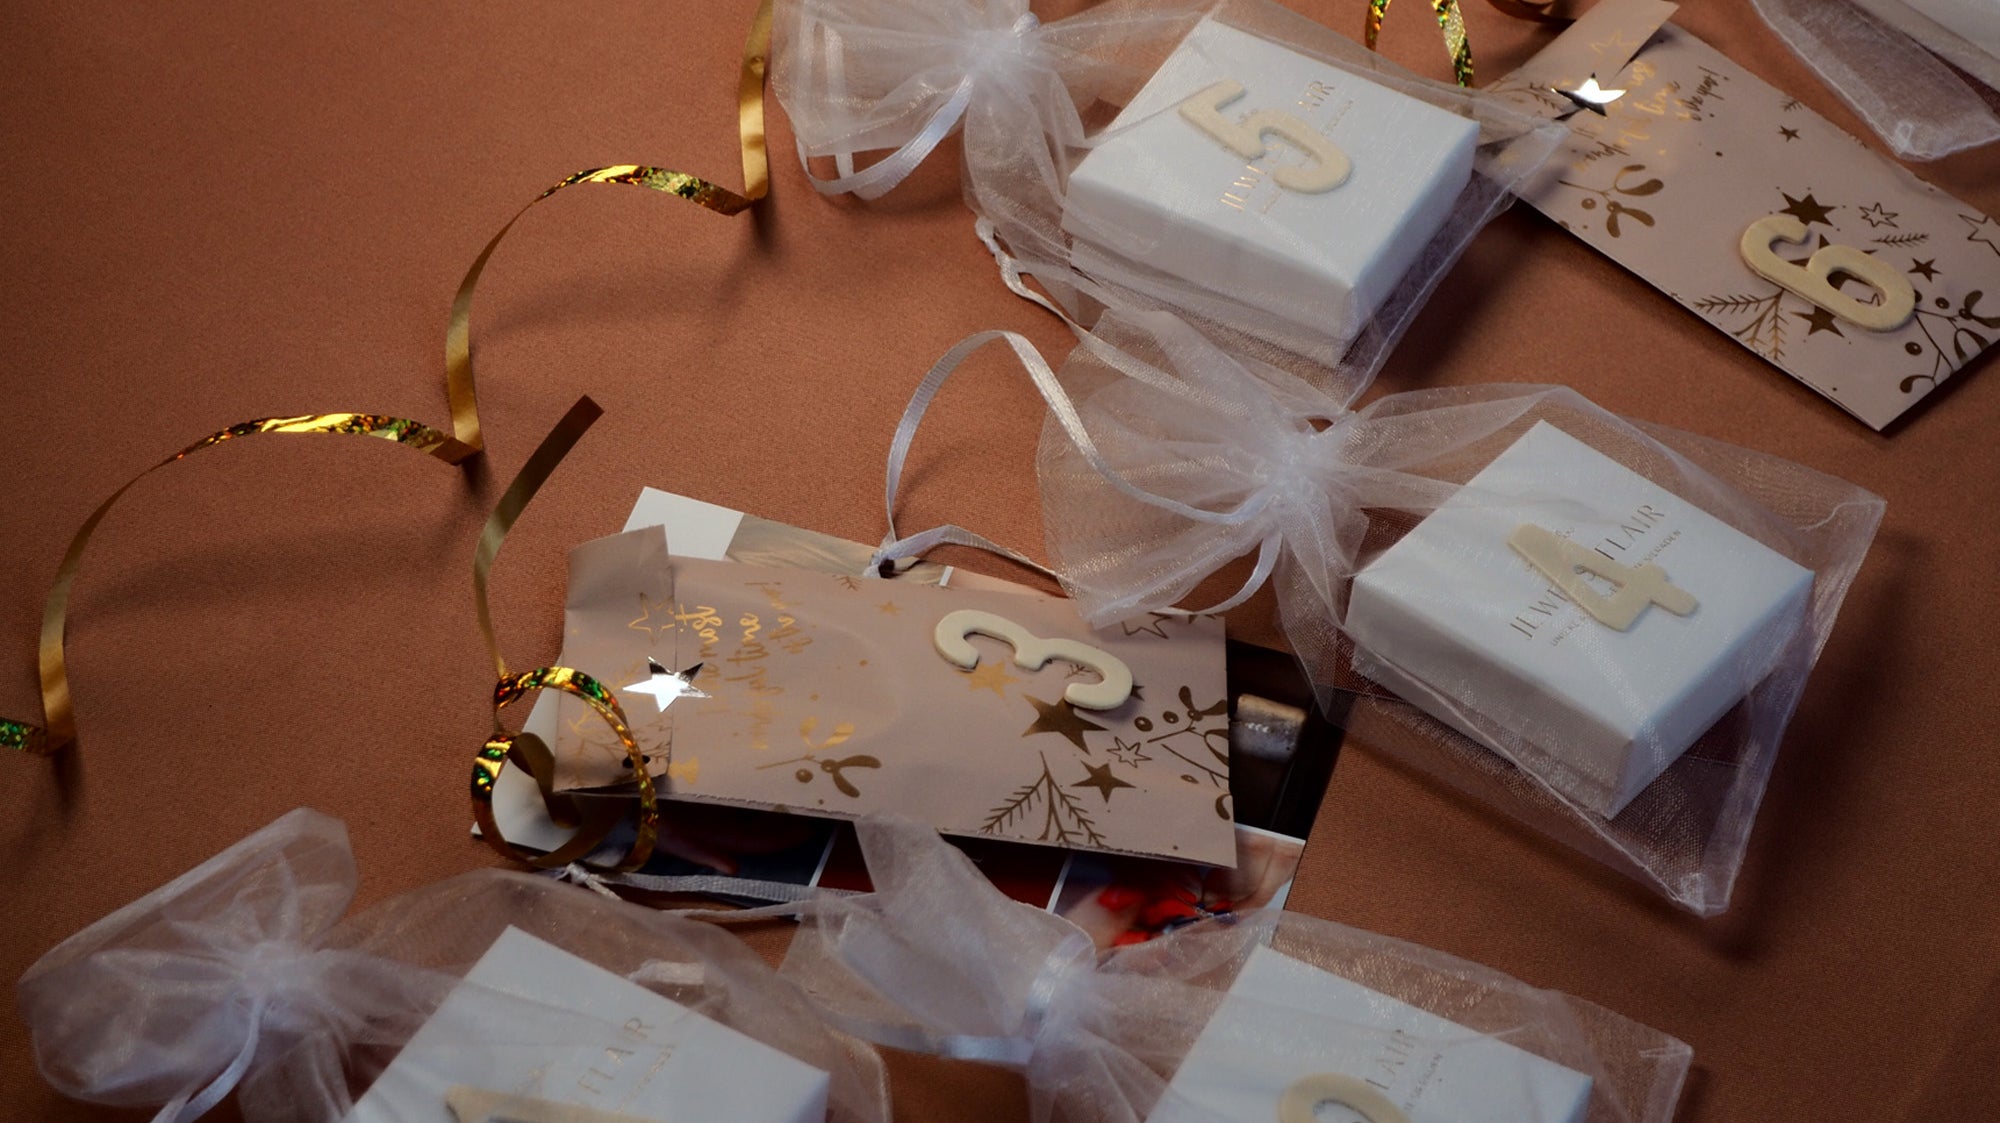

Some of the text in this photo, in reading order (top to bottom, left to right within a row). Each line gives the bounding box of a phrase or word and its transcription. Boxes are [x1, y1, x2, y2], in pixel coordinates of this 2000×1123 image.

[1178, 77, 1353, 195] 5
[1740, 214, 1917, 334] 6
[1507, 523, 1698, 633] 4
[1594, 503, 1665, 561] FLAIR
[726, 611, 770, 667] time
[934, 609, 1134, 710] 3
